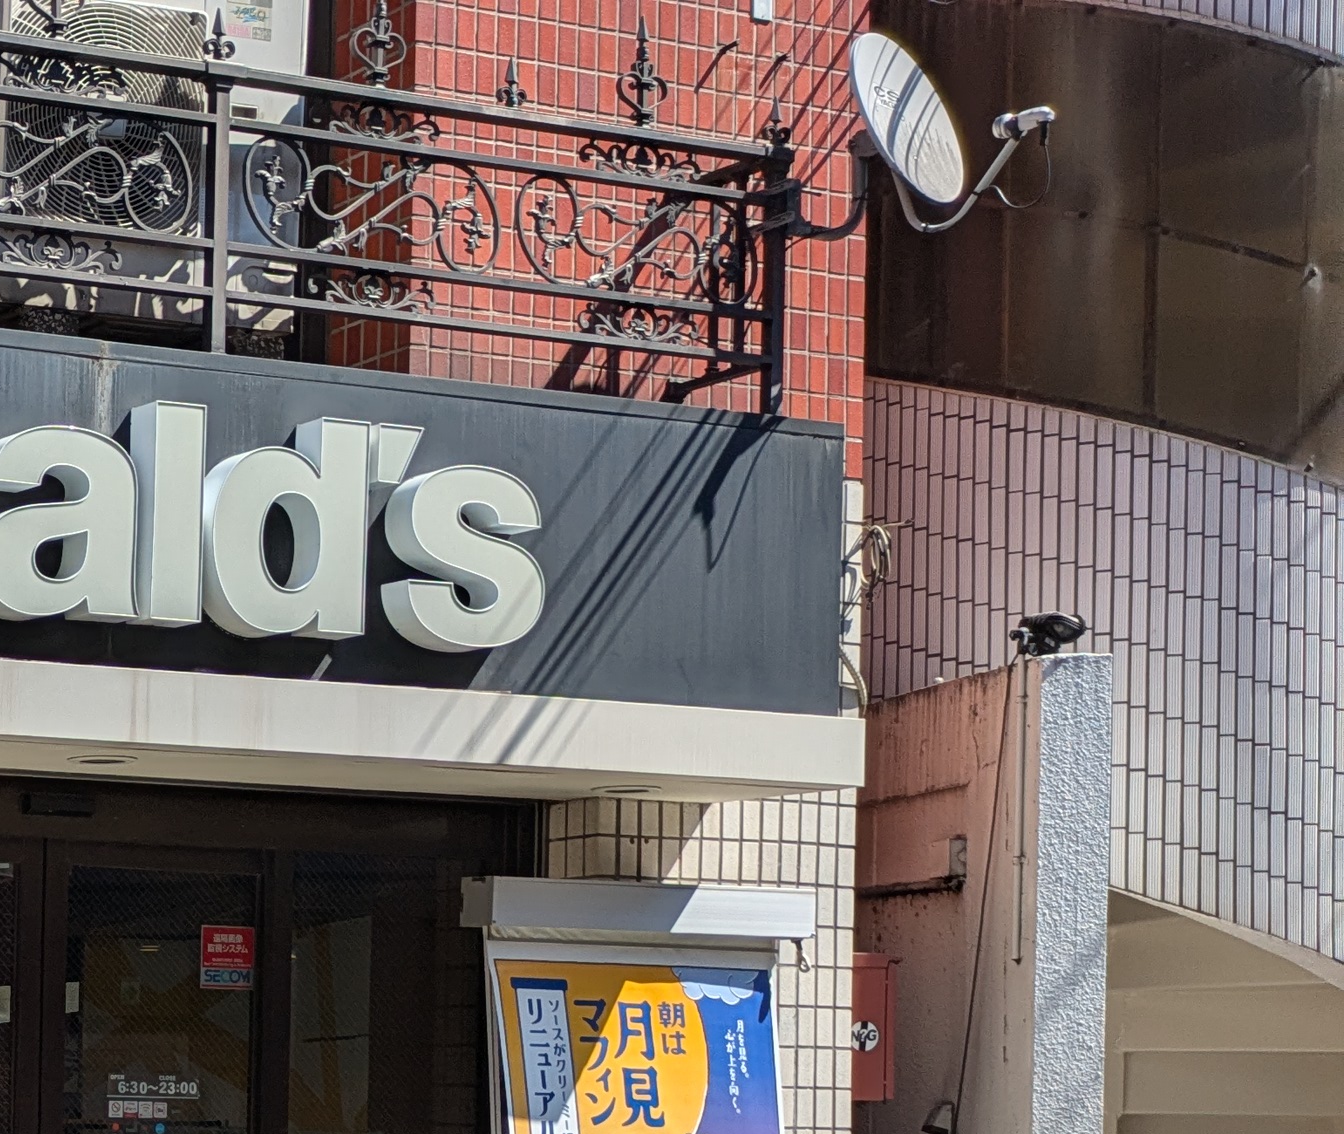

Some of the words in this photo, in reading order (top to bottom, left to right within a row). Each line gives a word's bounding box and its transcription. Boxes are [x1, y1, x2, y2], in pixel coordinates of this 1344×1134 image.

[204, 969, 251, 983] SECOM
[573, 998, 617, 1127] マフィン
[614, 1000, 666, 1128] 月見
[657, 1002, 687, 1056] 朝は
